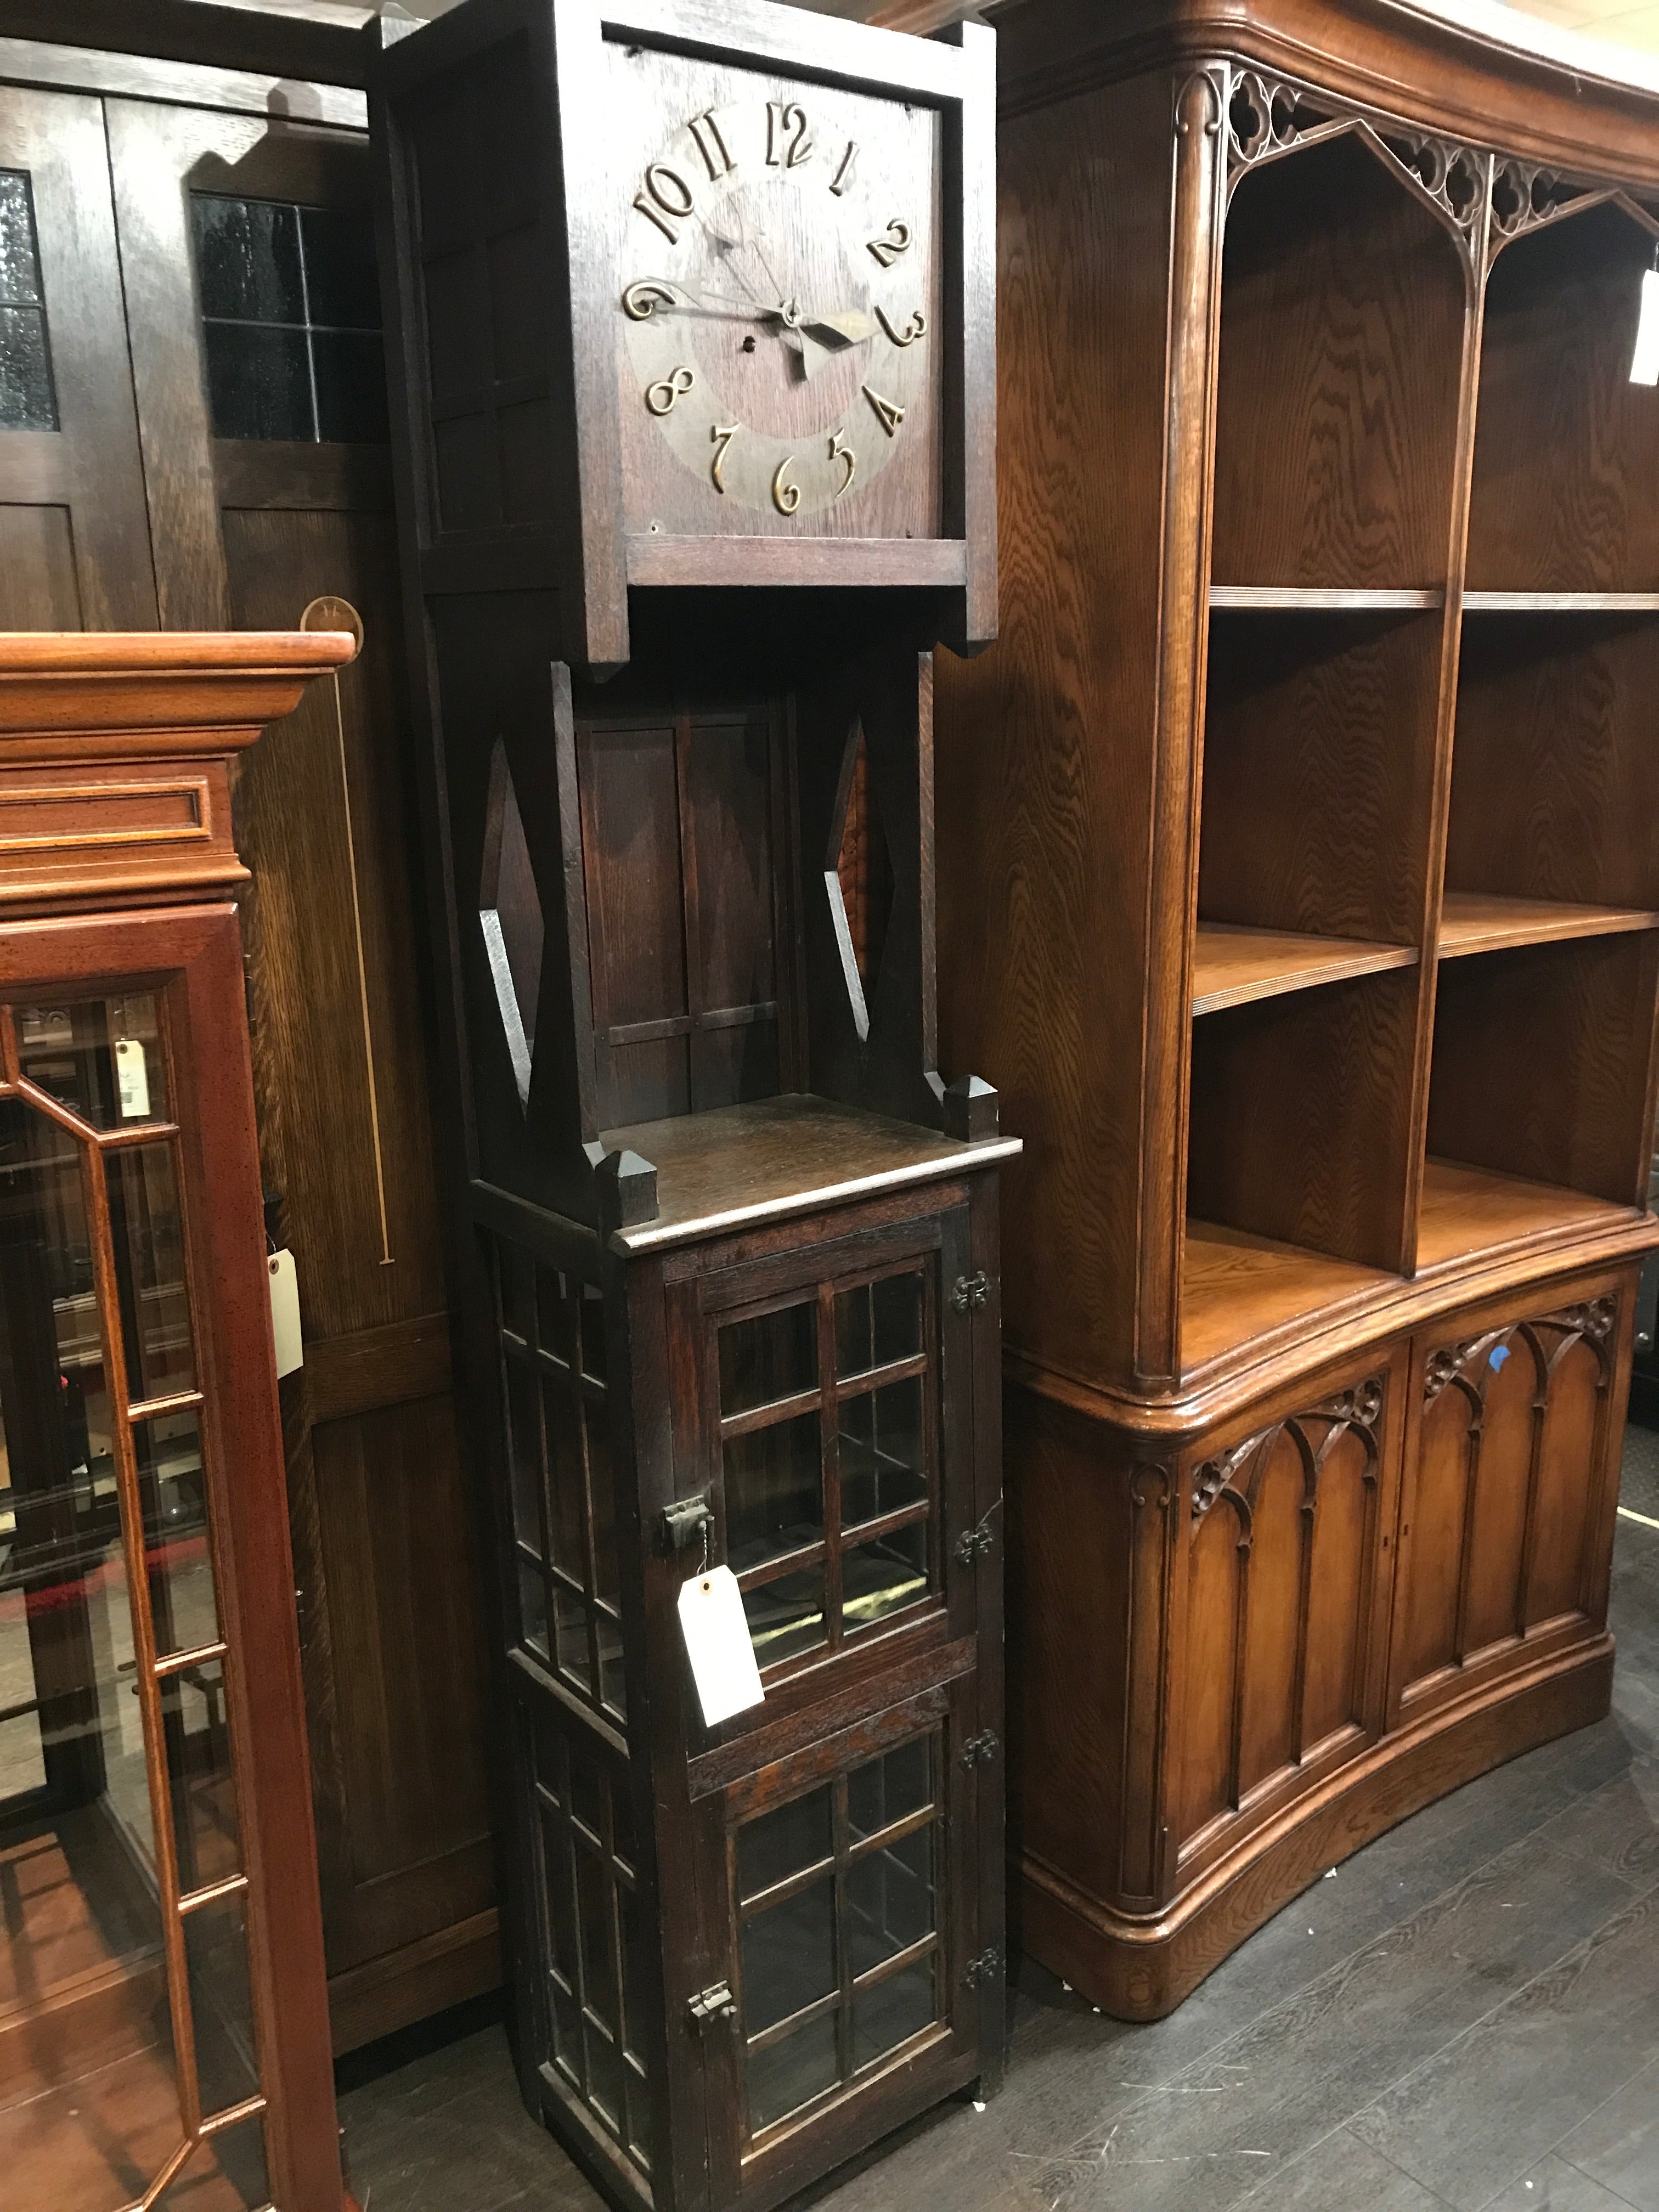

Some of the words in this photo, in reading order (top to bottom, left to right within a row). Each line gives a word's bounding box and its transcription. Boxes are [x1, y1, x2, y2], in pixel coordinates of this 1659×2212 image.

[688, 108, 739, 181] 11
[766, 102, 813, 168] 12
[830, 140, 860, 196] 1
[633, 163, 696, 245] 10
[866, 219, 912, 268] 2
[622, 280, 676, 321] 9
[876, 305, 928, 347] 3
[645, 366, 696, 416] 8
[862, 385, 905, 437] 4
[711, 421, 742, 494] 7
[772, 455, 801, 516] 6
[830, 427, 857, 498] 5
